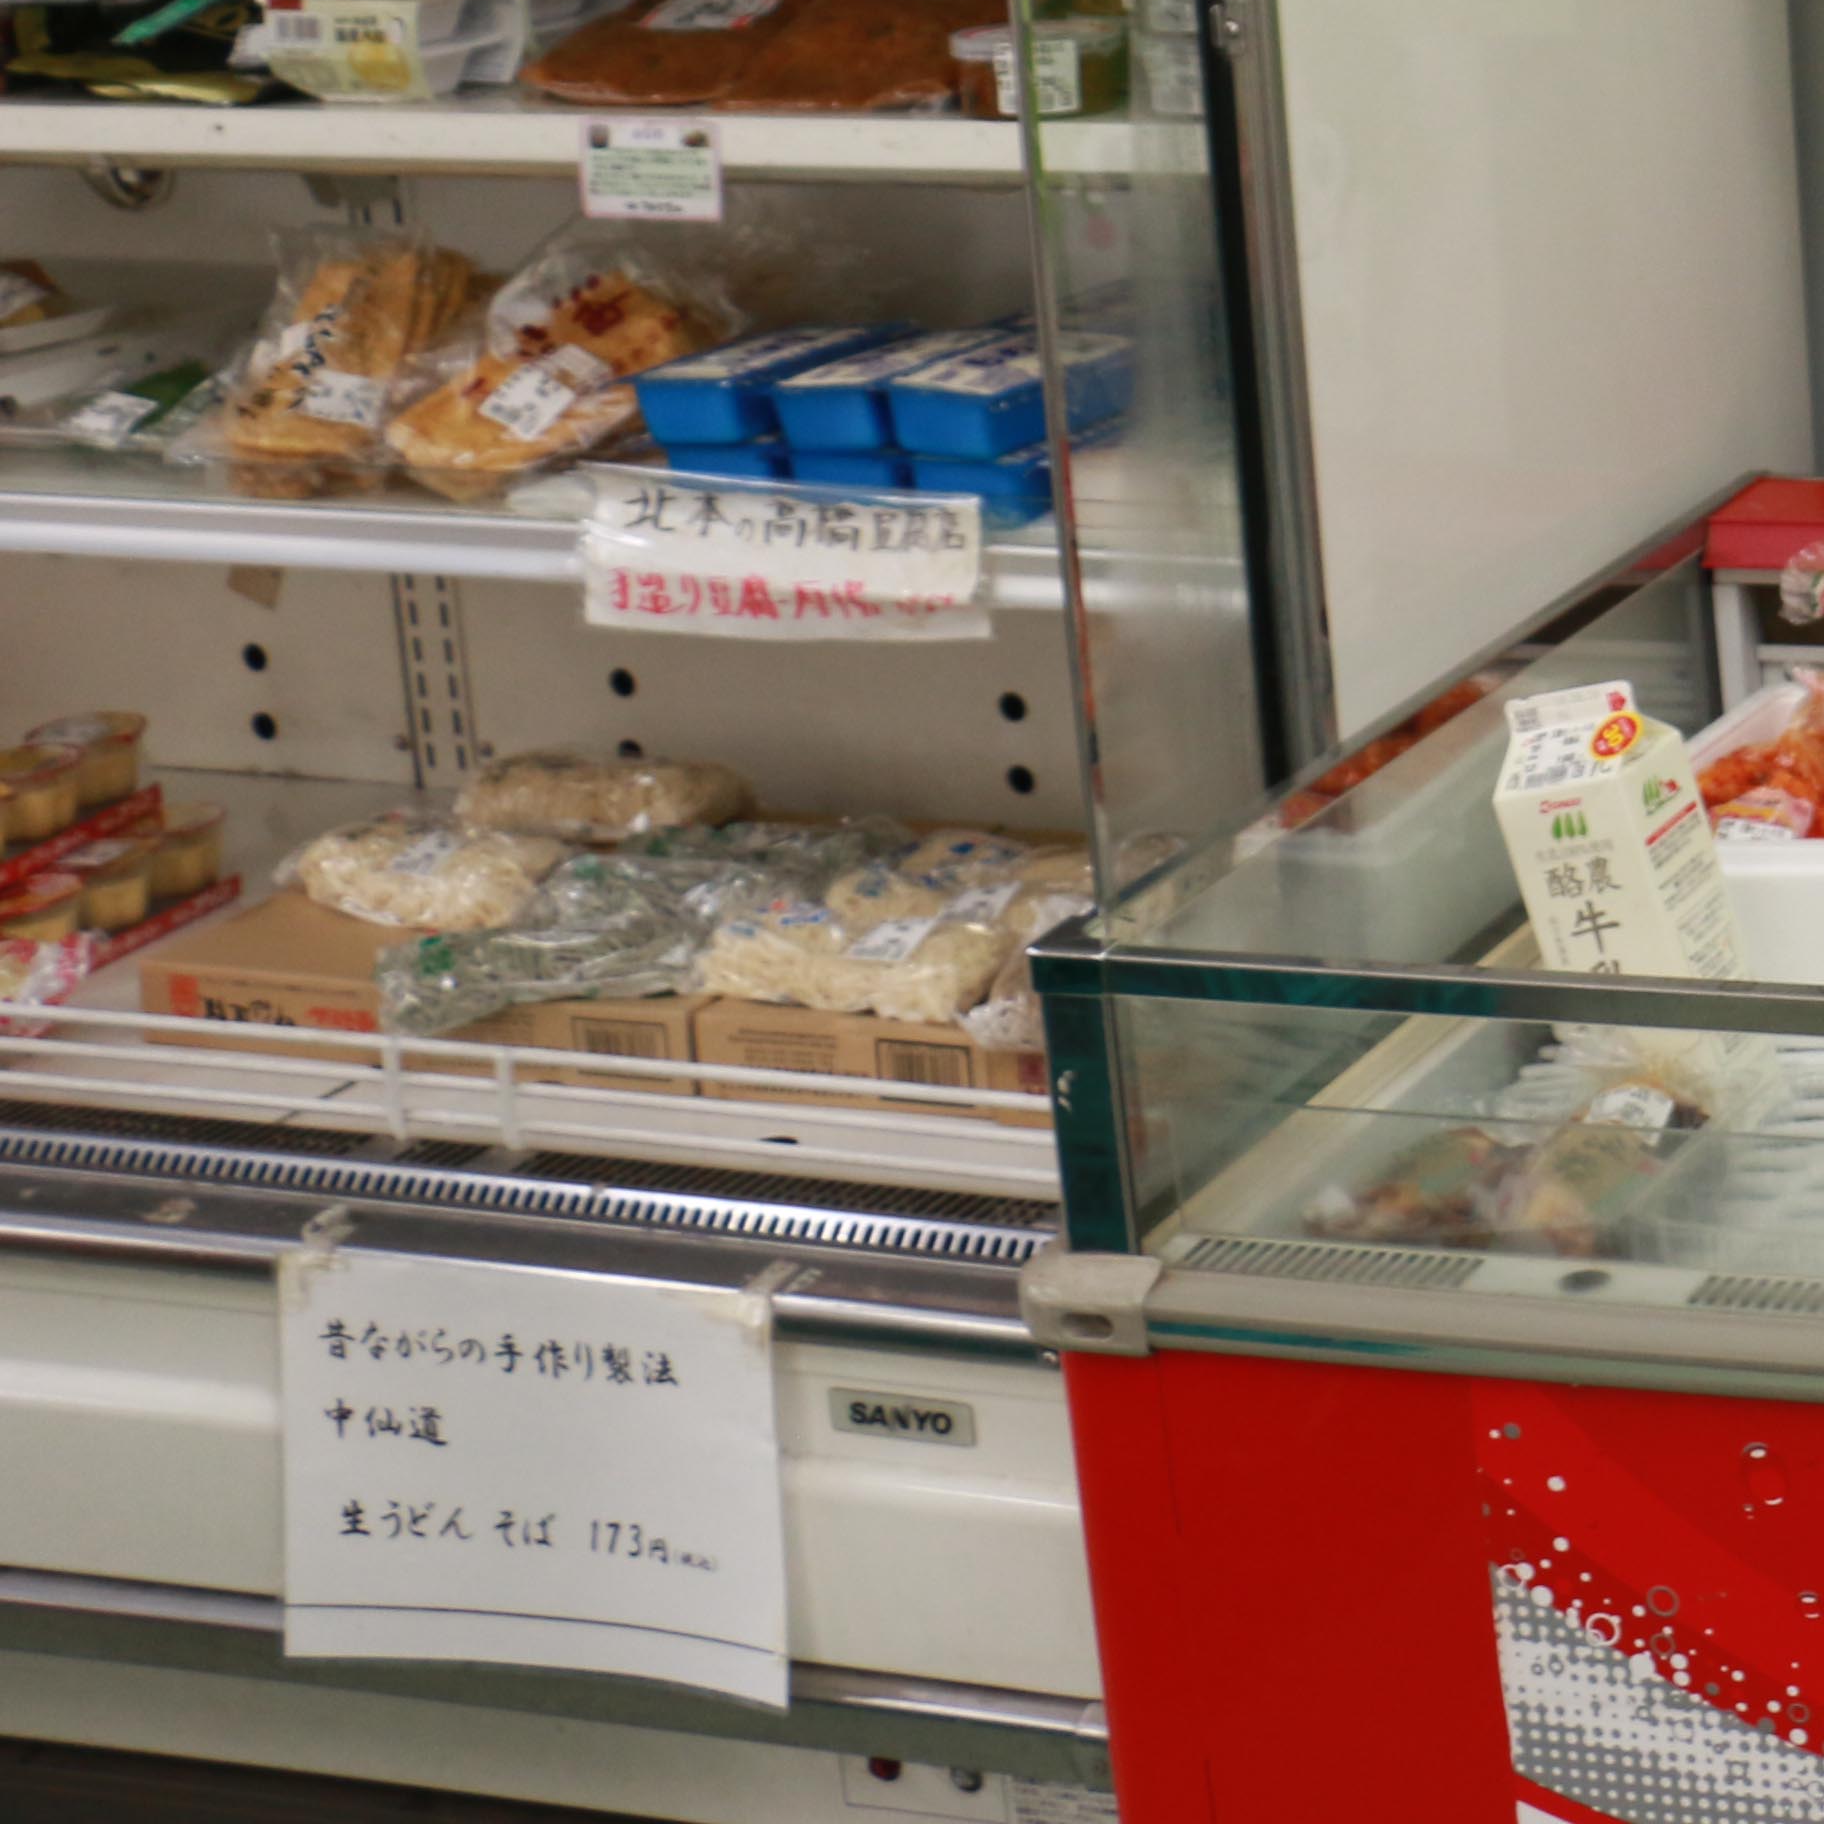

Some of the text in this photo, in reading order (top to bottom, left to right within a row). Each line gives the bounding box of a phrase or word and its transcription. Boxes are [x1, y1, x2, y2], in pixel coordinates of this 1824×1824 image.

[318, 1321, 680, 1388] 昔ながらの手作り製法
[323, 1405, 449, 1447] 中仙道
[848, 1400, 953, 1437] SANYO
[339, 1498, 473, 1543] 生うどん
[494, 1512, 554, 1549] そば
